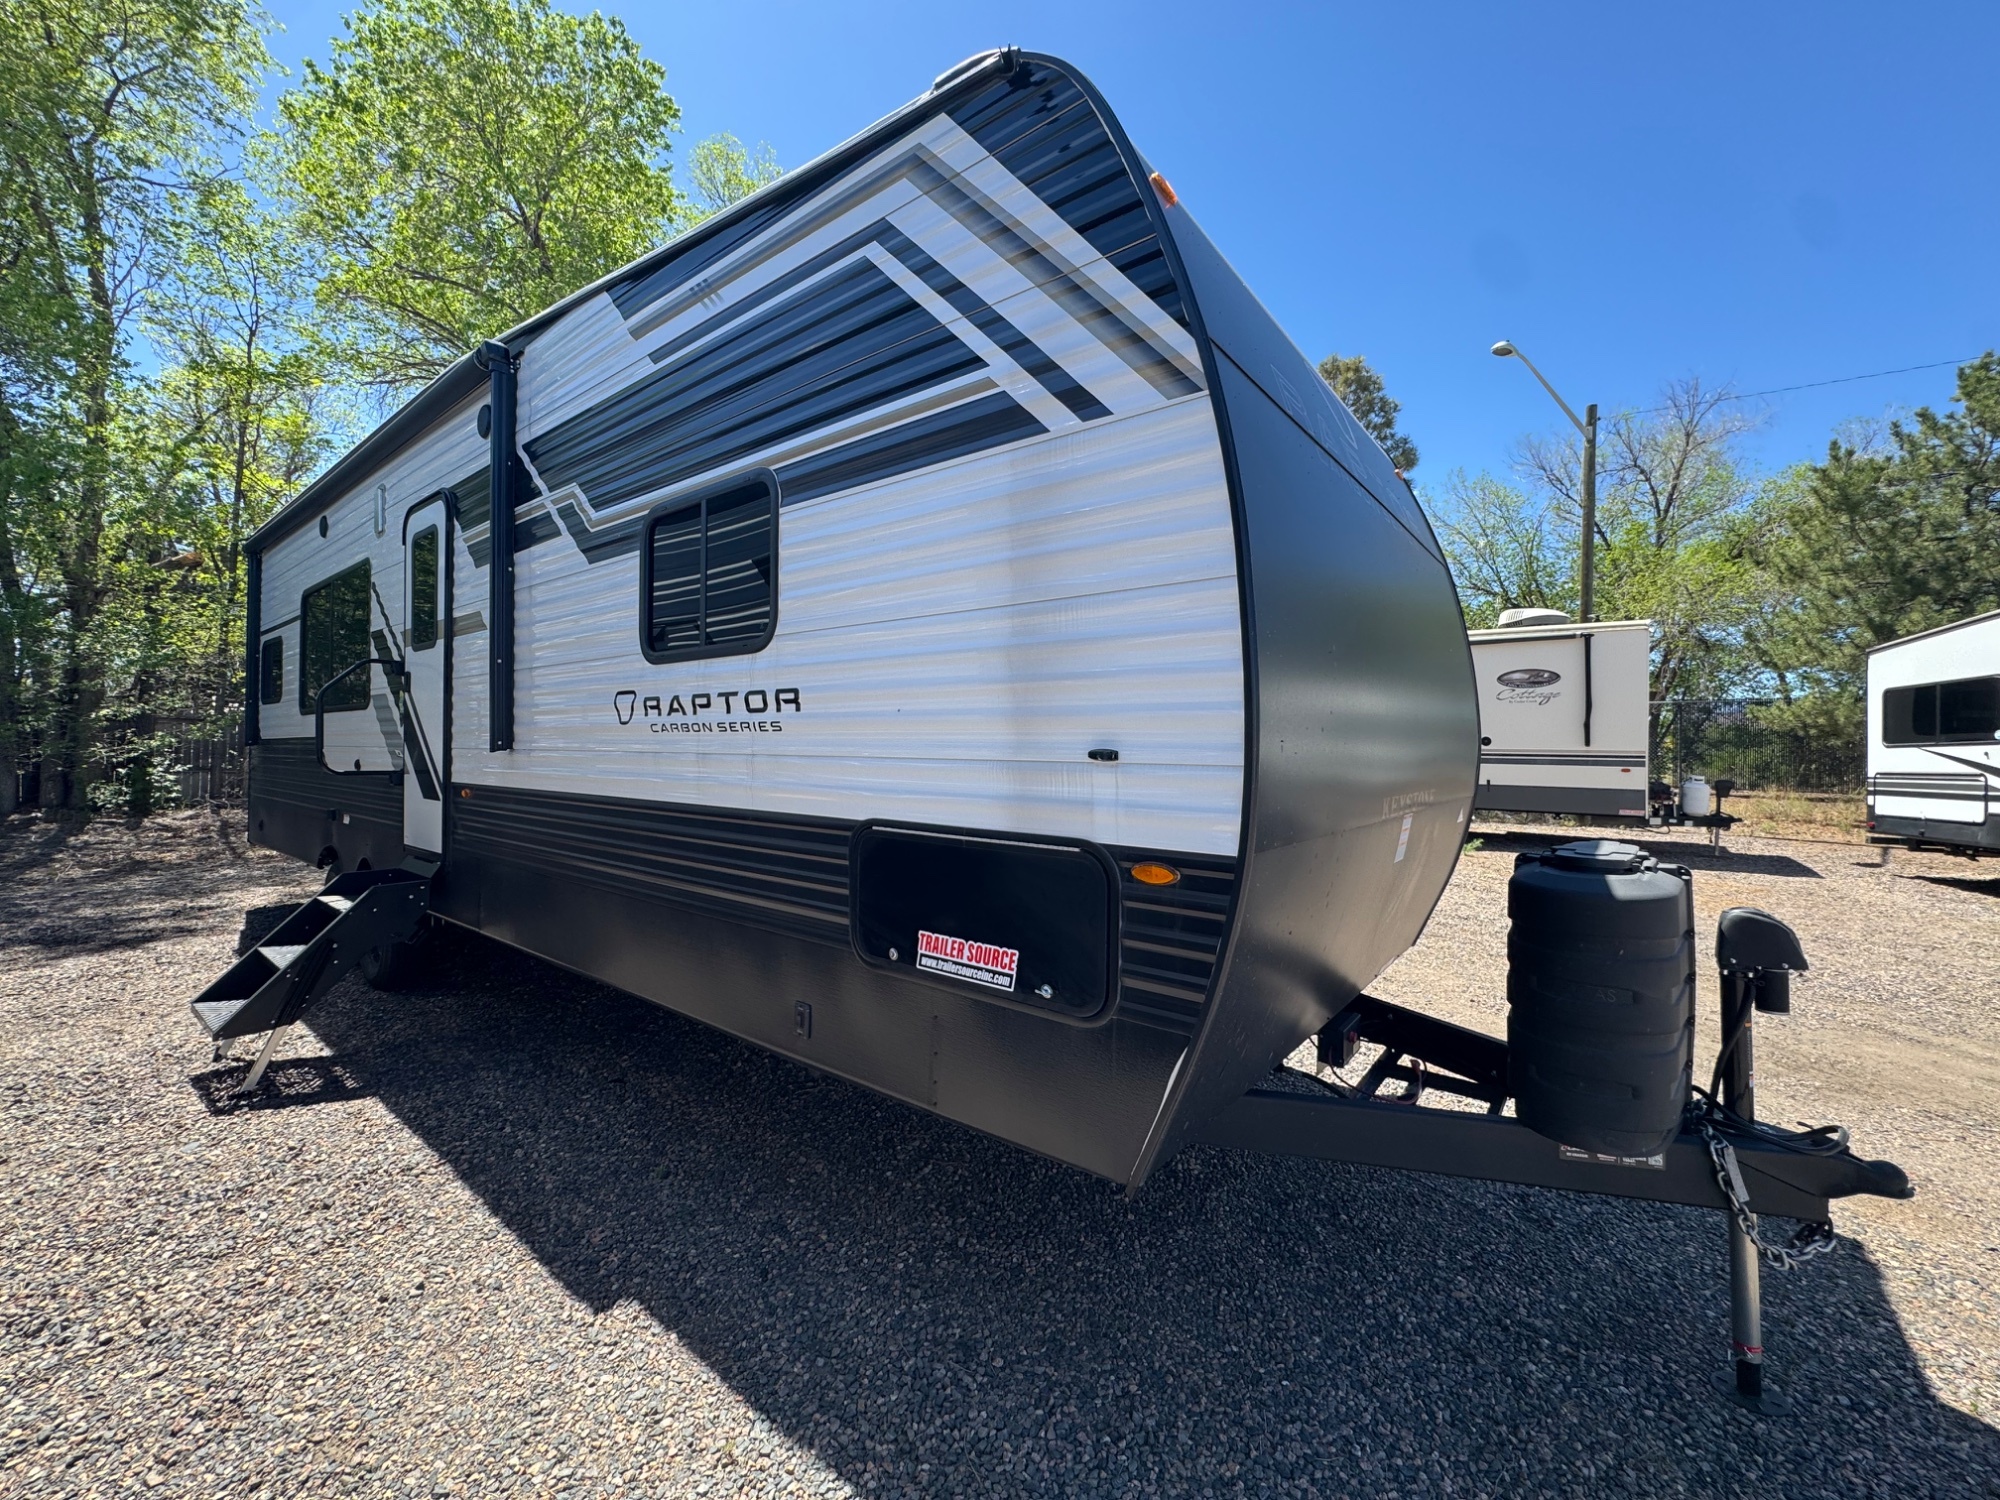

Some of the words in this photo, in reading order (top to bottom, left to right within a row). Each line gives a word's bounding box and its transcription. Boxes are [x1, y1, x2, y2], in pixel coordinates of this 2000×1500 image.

[643, 687, 802, 717] RAPTOR
[1496, 688, 1561, 706] Cottage
[650, 722, 713, 733] CARBON
[716, 721, 783, 732] SERIES
[919, 932, 966, 960] TRAILER
[966, 942, 1017, 972] SOURCE
[920, 956, 1011, 987] www.trailersourceinc.com
